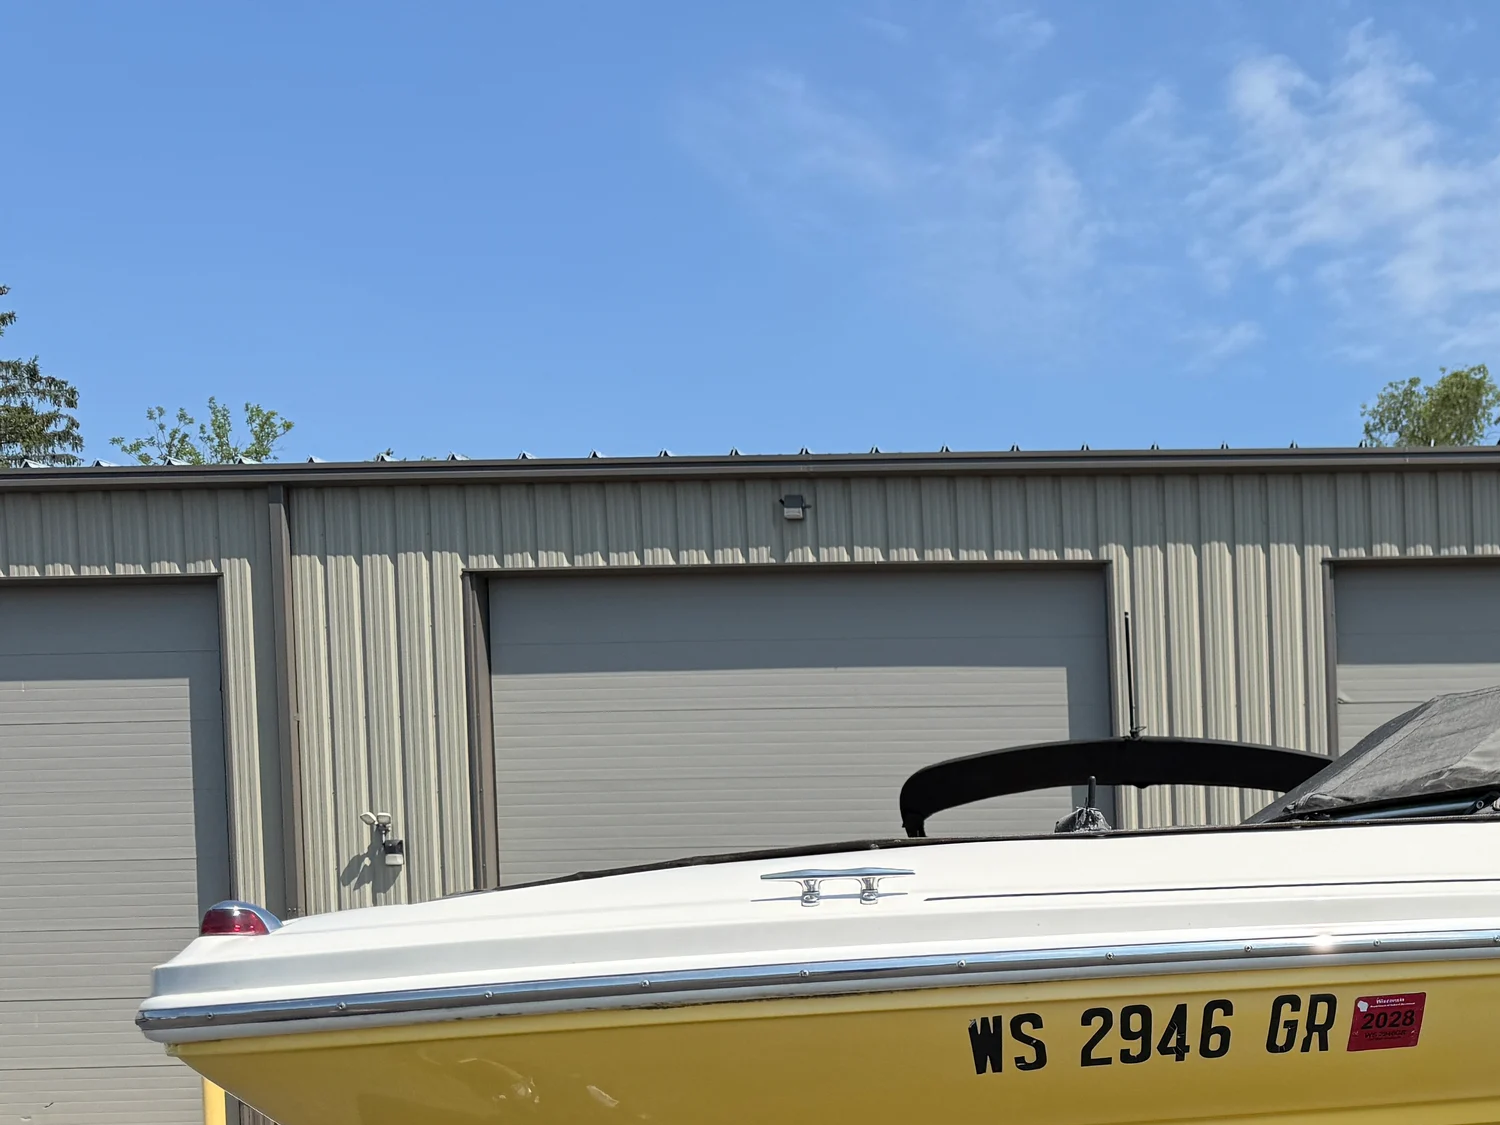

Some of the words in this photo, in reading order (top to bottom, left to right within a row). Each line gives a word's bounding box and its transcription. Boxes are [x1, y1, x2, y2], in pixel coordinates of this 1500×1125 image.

[968, 1012, 1048, 1075] WS
[1080, 999, 1234, 1068] 2946
[1265, 993, 1338, 1054] GR
[1361, 1009, 1415, 1030] 2028
